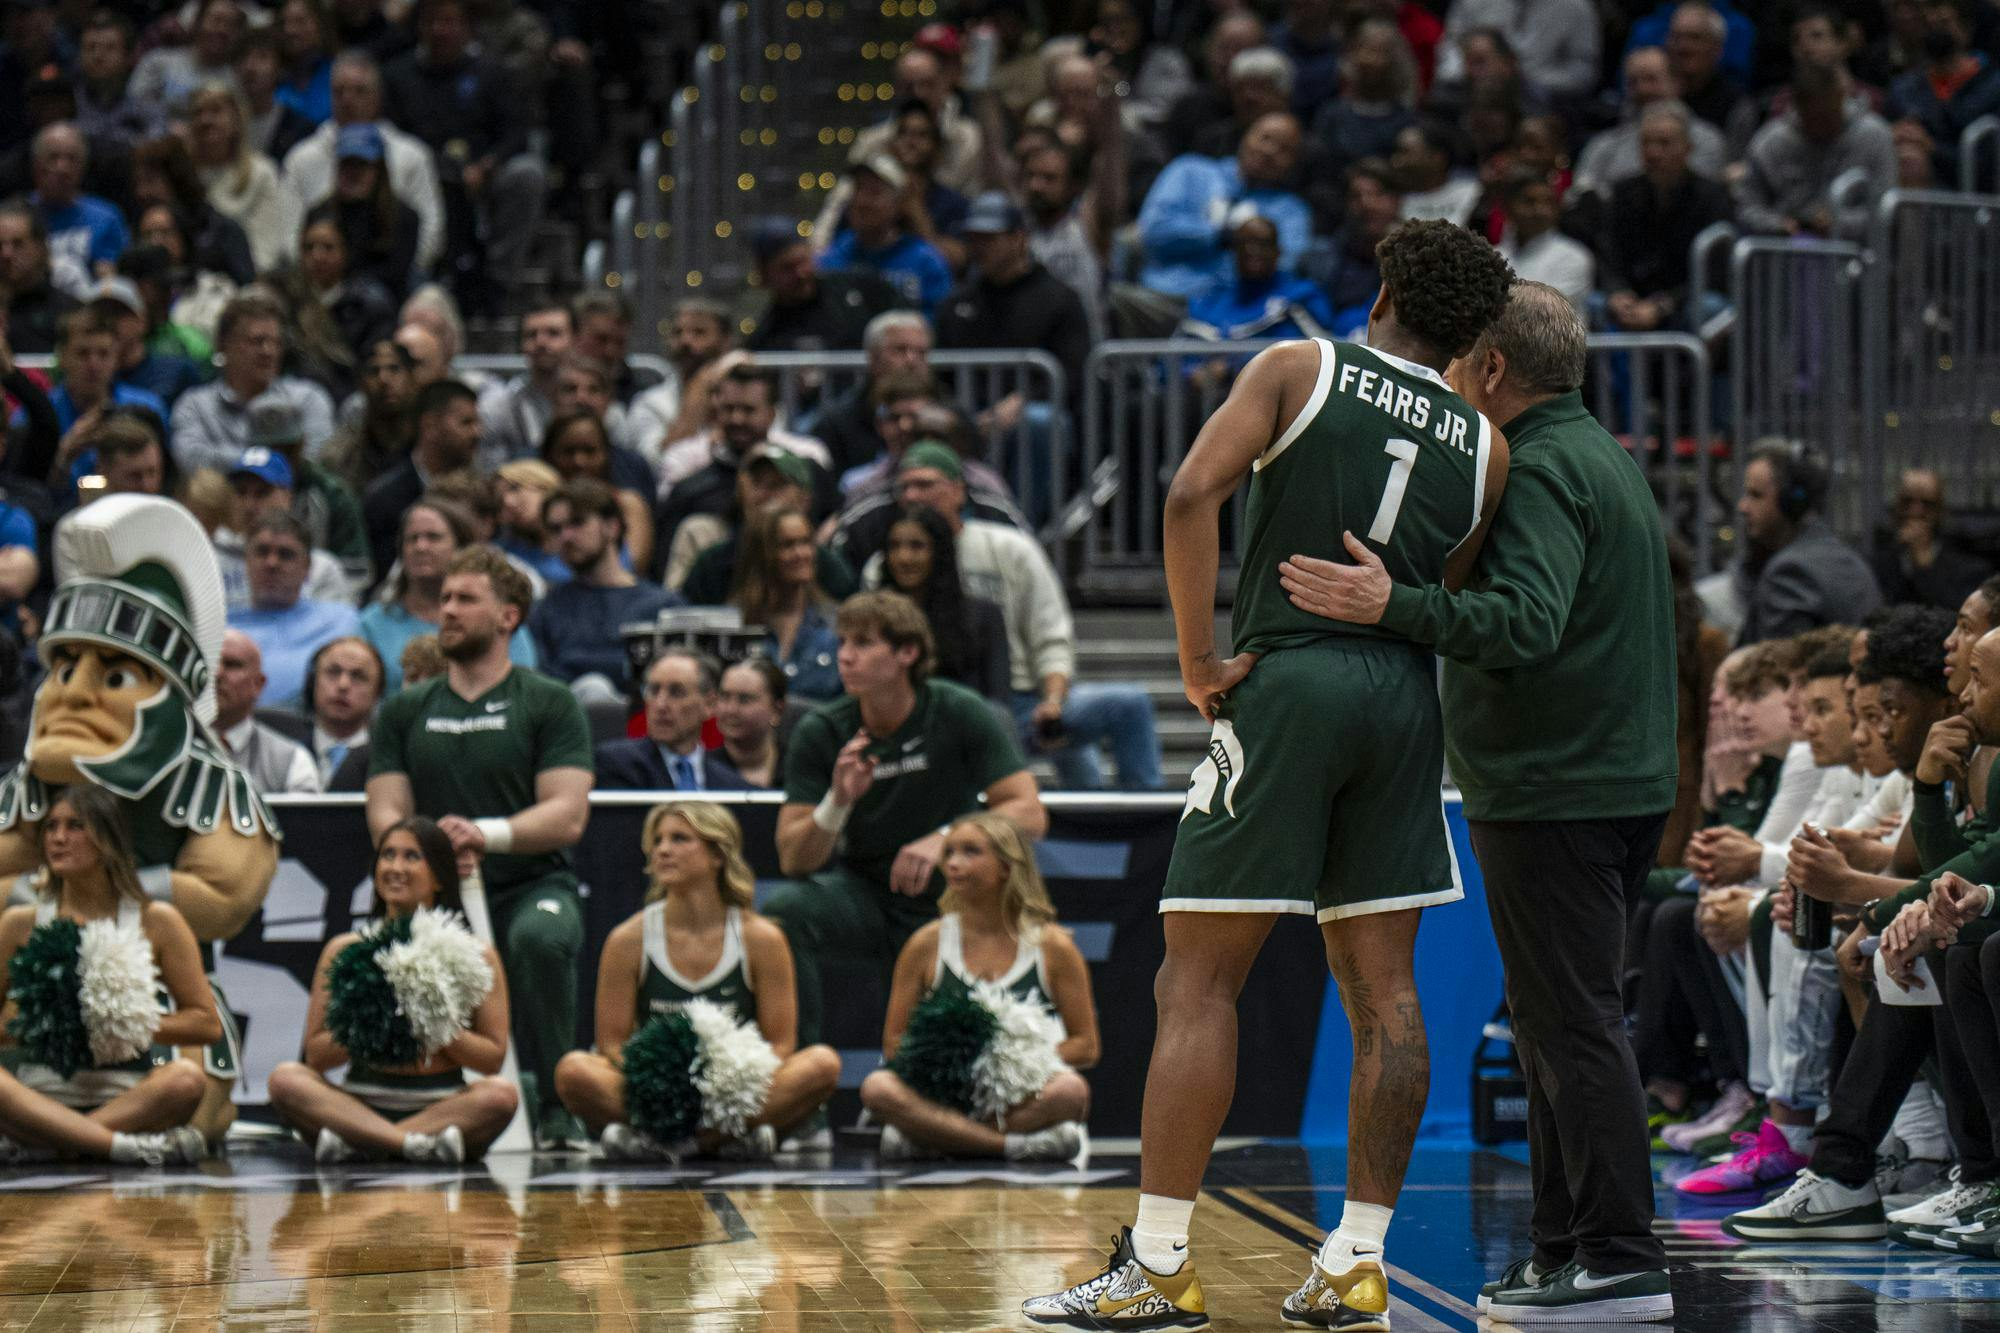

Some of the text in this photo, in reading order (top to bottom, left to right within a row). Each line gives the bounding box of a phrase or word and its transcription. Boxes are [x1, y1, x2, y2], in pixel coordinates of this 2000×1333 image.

[1338, 363, 1474, 456] FEARS JR.
[1367, 438, 1419, 545] 1
